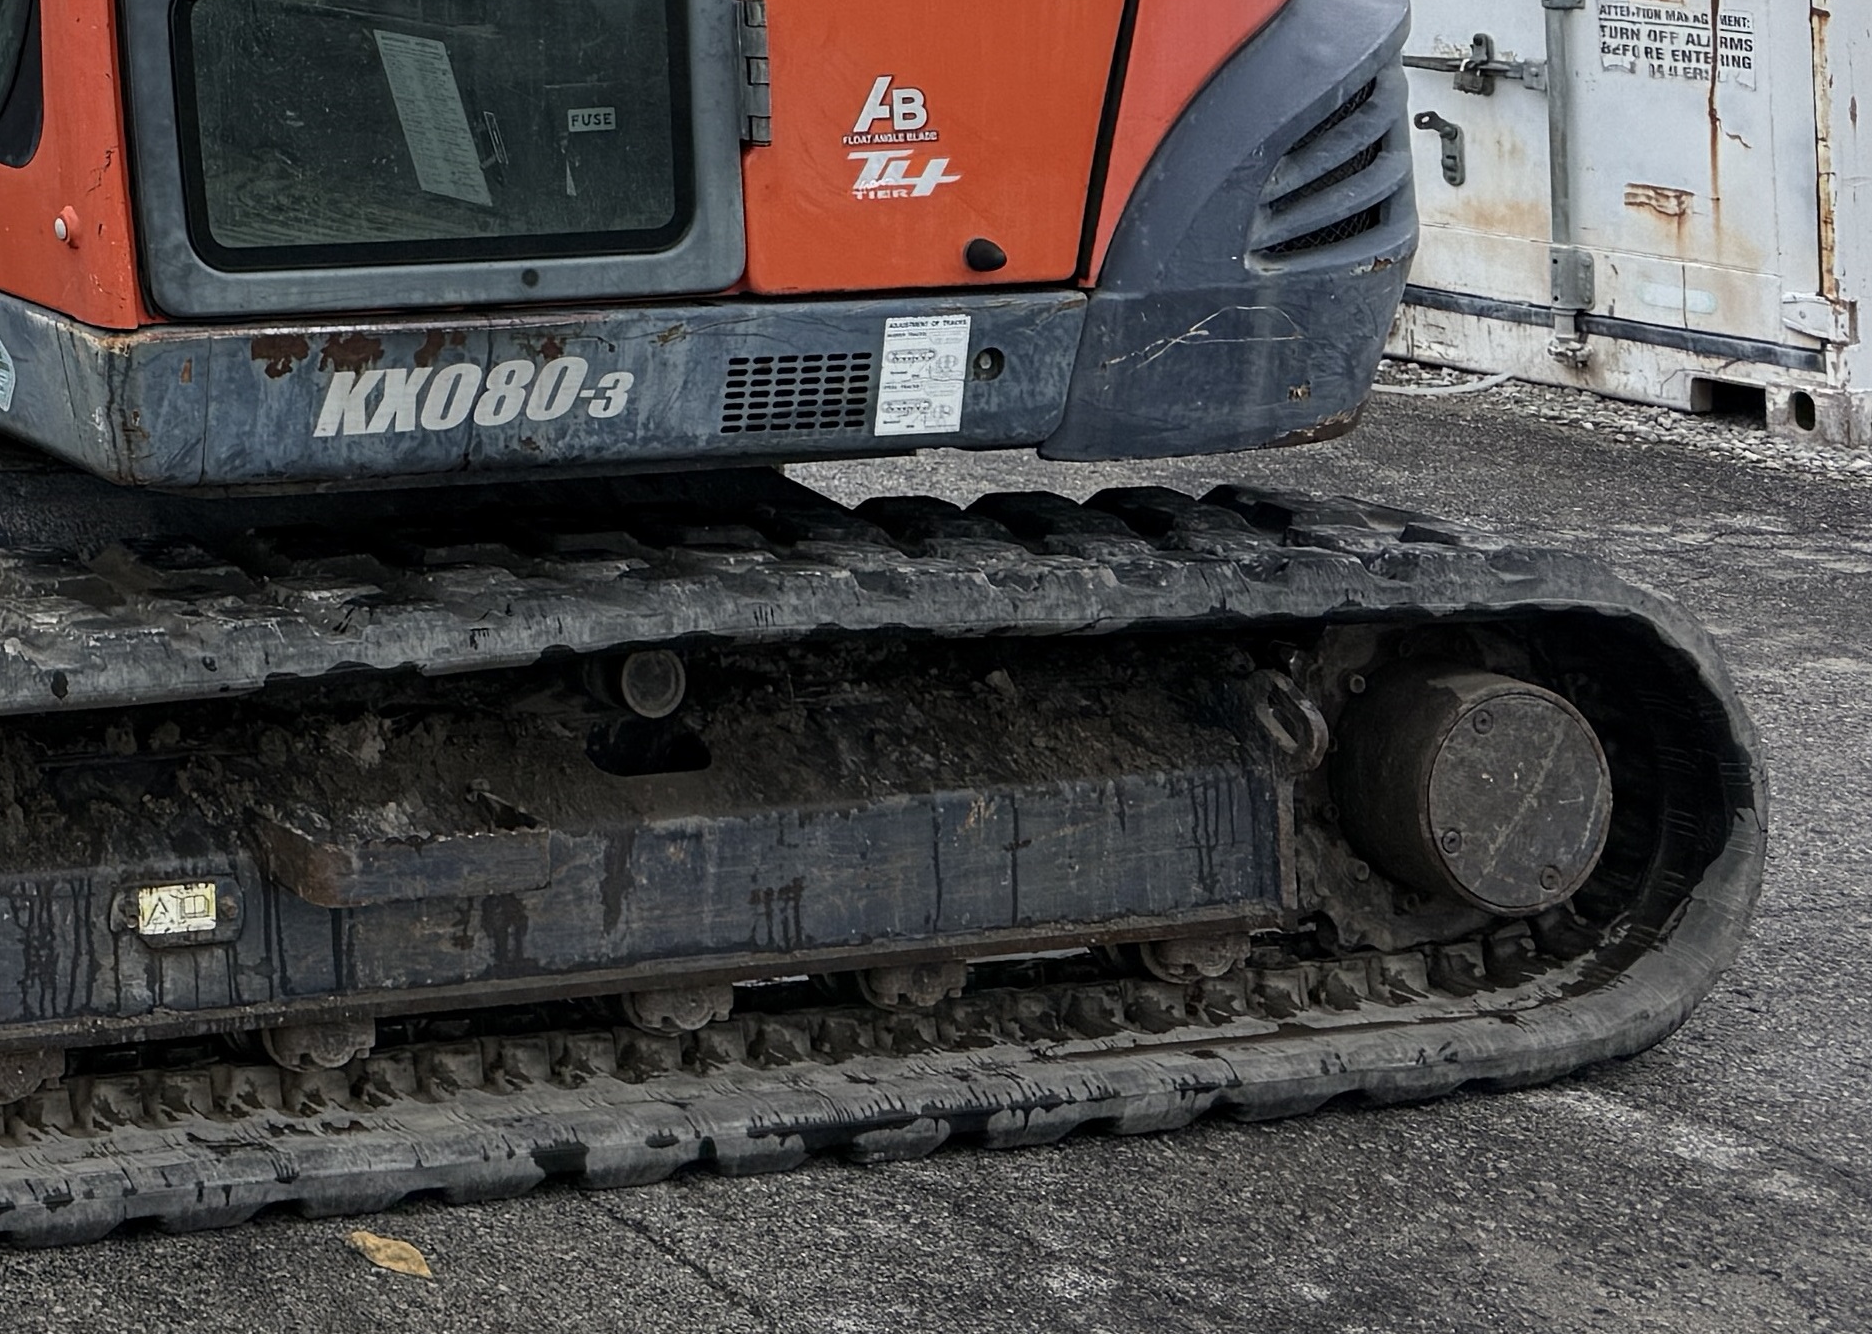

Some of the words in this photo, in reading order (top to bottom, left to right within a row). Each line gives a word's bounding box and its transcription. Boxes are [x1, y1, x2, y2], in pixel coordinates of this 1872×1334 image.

[1600, 23, 1641, 41] TURN
[1647, 29, 1679, 46] OFF
[571, 113, 612, 127] FUSE
[842, 135, 871, 145] FLOAT
[873, 133, 904, 143] ANGLE
[906, 131, 938, 142] BLADE
[852, 188, 910, 199] TIER
[312, 356, 635, 438] KX080-3
